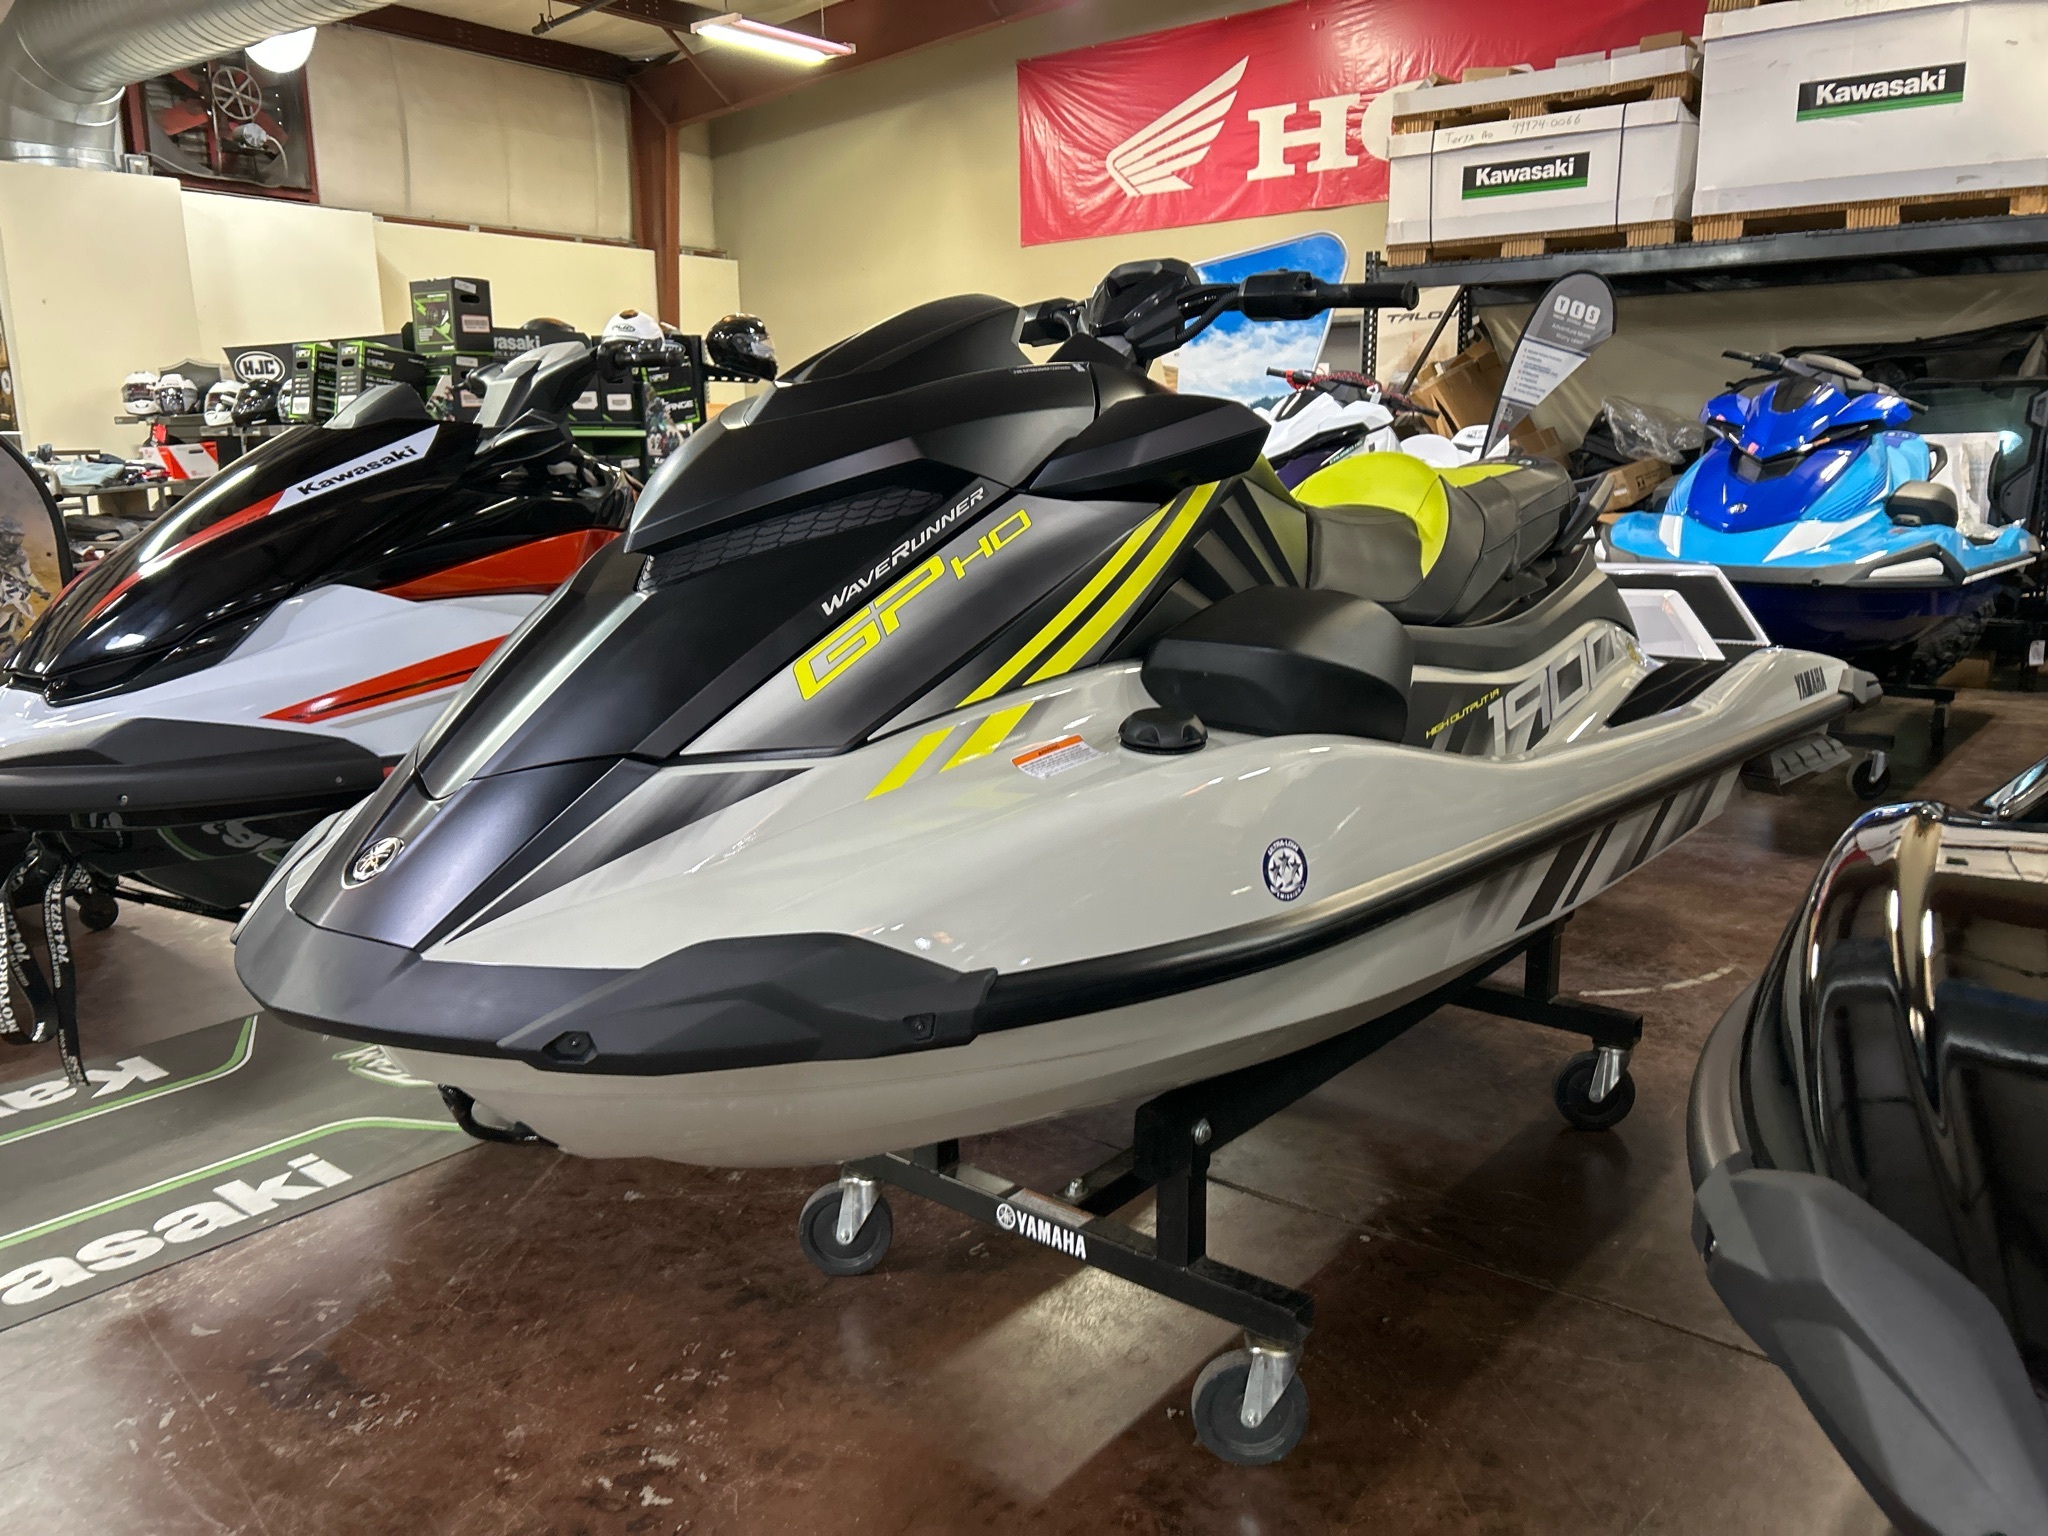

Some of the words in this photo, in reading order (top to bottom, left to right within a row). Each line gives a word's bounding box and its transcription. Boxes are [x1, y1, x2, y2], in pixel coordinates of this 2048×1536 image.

[1815, 68, 1947, 106] Kawasaki
[1475, 156, 1575, 187] Kawasaki
[242, 359, 276, 376] HJC
[296, 445, 418, 496] Kawasaki
[820, 486, 985, 616] WAVERUNNER
[792, 554, 946, 701] GP
[950, 508, 1033, 581] HO
[1487, 628, 1624, 757] 1900
[1793, 665, 1828, 701] YAMAHA
[1425, 719, 1450, 740] HIGH
[1450, 694, 1489, 723] OUTPUT
[0, 1055, 170, 1119] Ka
[1, 1151, 354, 1305] asaki
[1015, 1209, 1087, 1261] YAMAHA
